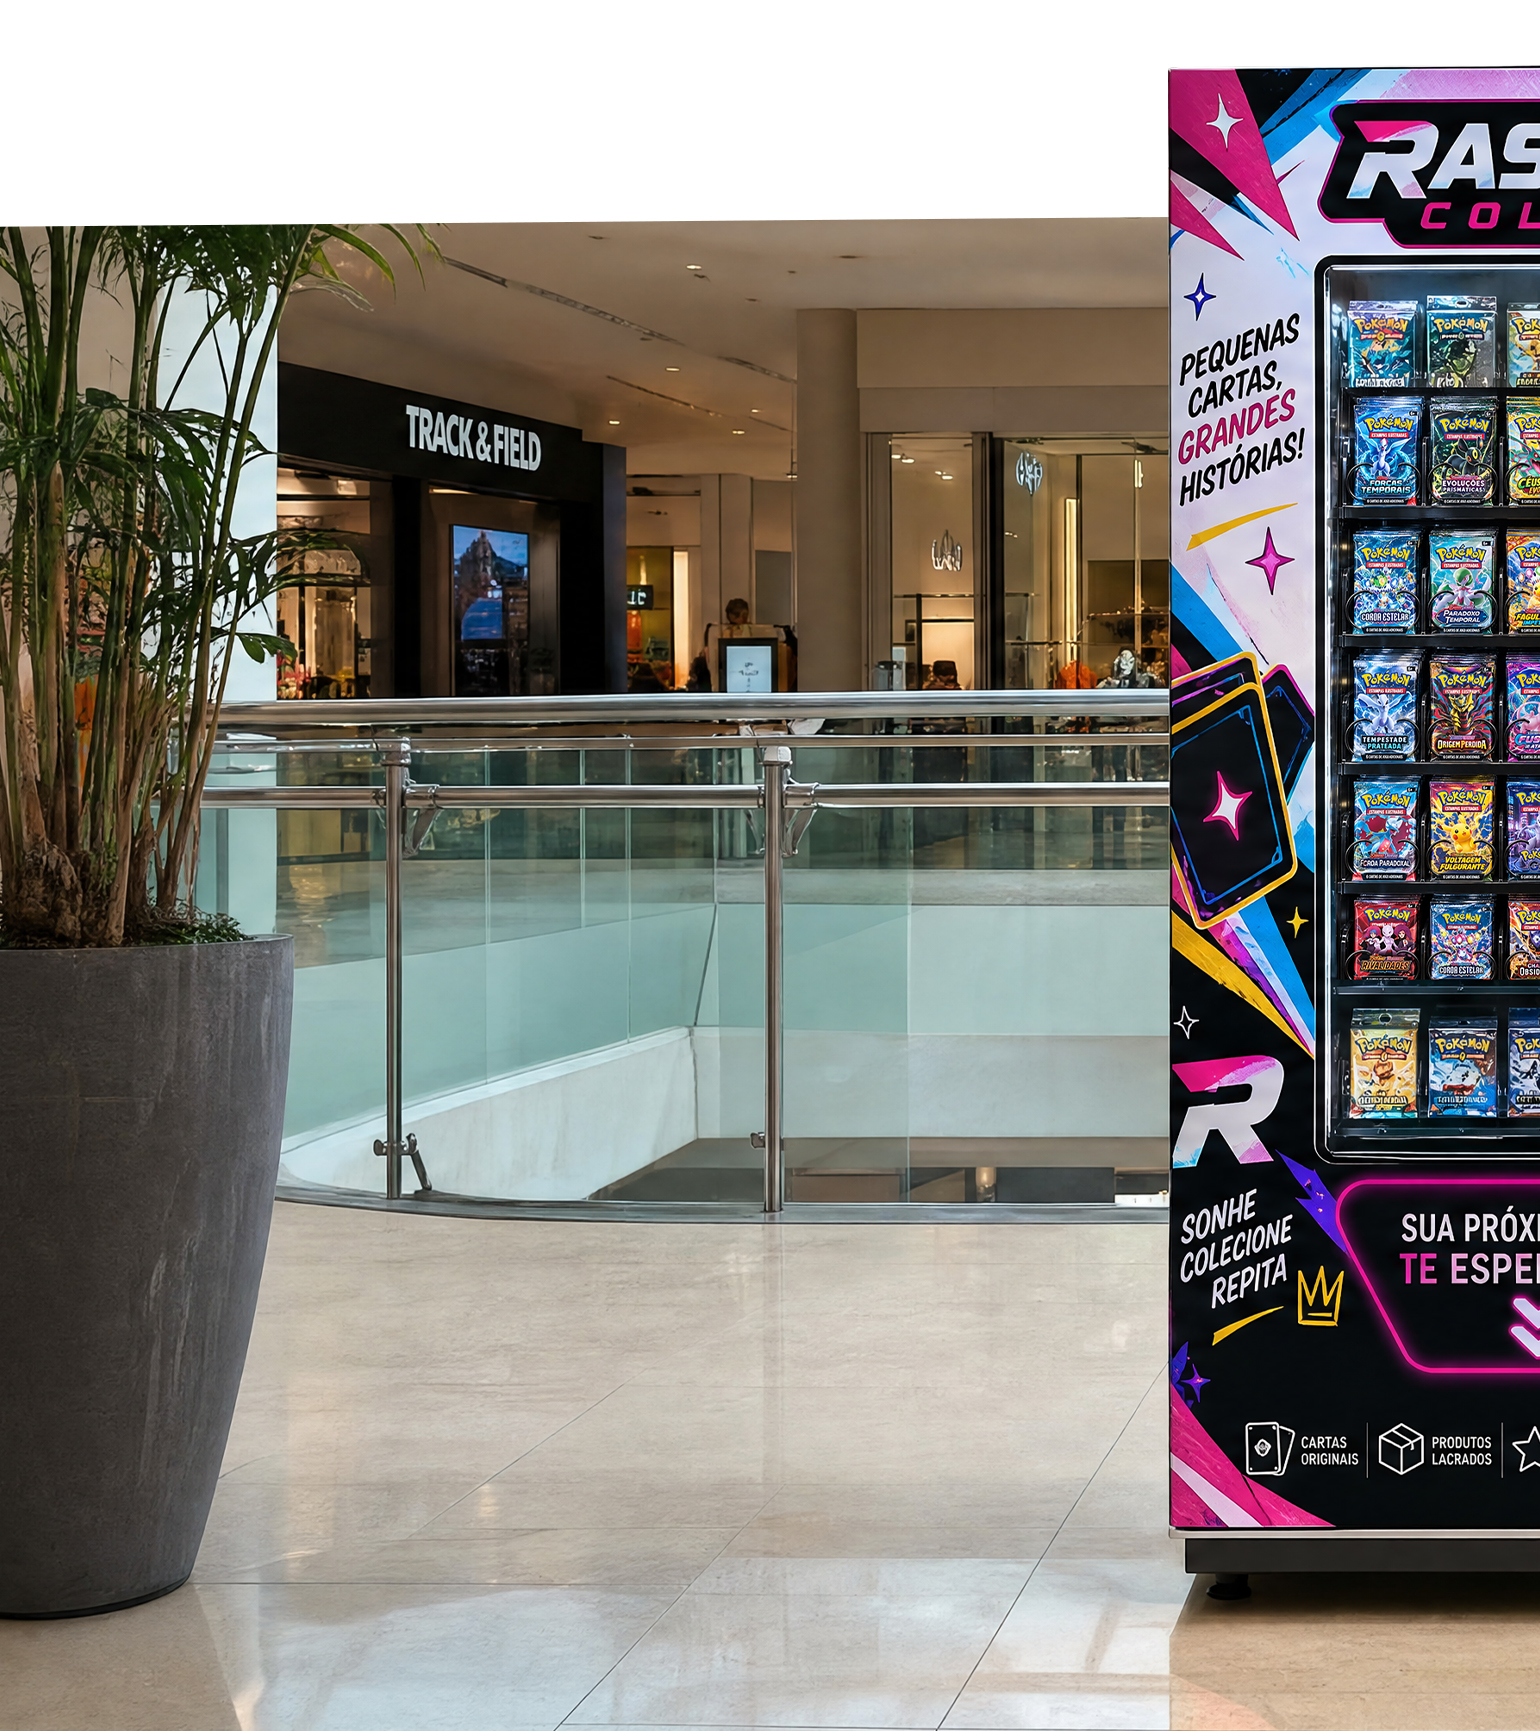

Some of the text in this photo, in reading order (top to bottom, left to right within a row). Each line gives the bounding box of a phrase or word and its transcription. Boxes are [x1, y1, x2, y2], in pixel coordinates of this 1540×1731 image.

[1180, 313, 1300, 386] PEQUENAS
[1188, 360, 1282, 418] CARTAS,
[1178, 388, 1295, 465] GRANDES
[1364, 414, 1413, 431] Pokémon
[1439, 414, 1490, 432] Pokémon
[406, 404, 541, 471] TRACK & FIELD
[1180, 428, 1305, 506] HISTÓRIAS!
[1361, 544, 1410, 561] Pokémon
[1437, 544, 1487, 562] Pokémon
[1361, 671, 1411, 687] Pokémon
[1438, 671, 1487, 688] Pokémon
[1361, 790, 1411, 808] Pokémon
[1437, 788, 1487, 806] Pokémon
[1364, 906, 1411, 922] Pokémon
[1442, 911, 1482, 924] Pokémon
[1180, 1188, 1257, 1244] SONHE
[1401, 1213, 1455, 1242] SUA
[1180, 1214, 1293, 1283] COLECIONE
[1400, 1253, 1437, 1284] TE
[1212, 1253, 1287, 1309] REPITA
[1301, 1436, 1347, 1449] CARTAS
[1432, 1436, 1491, 1449] PRODUTOS
[1301, 1453, 1359, 1465] ORIGINAIS
[1432, 1453, 1492, 1465] LACRADOS
